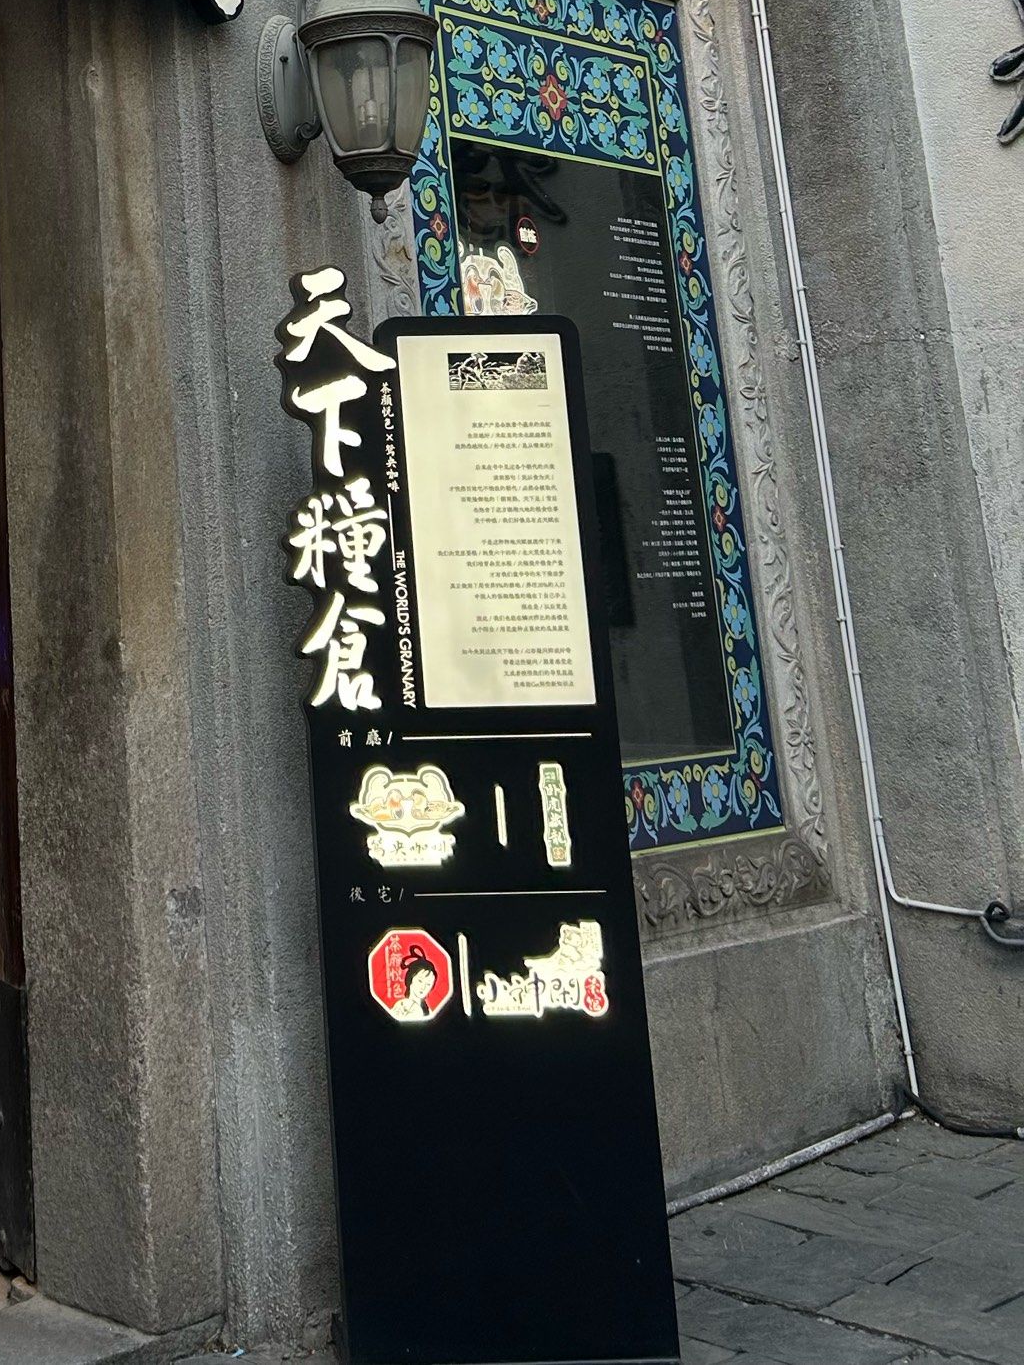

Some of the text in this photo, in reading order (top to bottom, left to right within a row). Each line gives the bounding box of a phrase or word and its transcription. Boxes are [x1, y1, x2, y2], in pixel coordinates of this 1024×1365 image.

[393, 549, 417, 709] THE WORLD'S GRANARY
